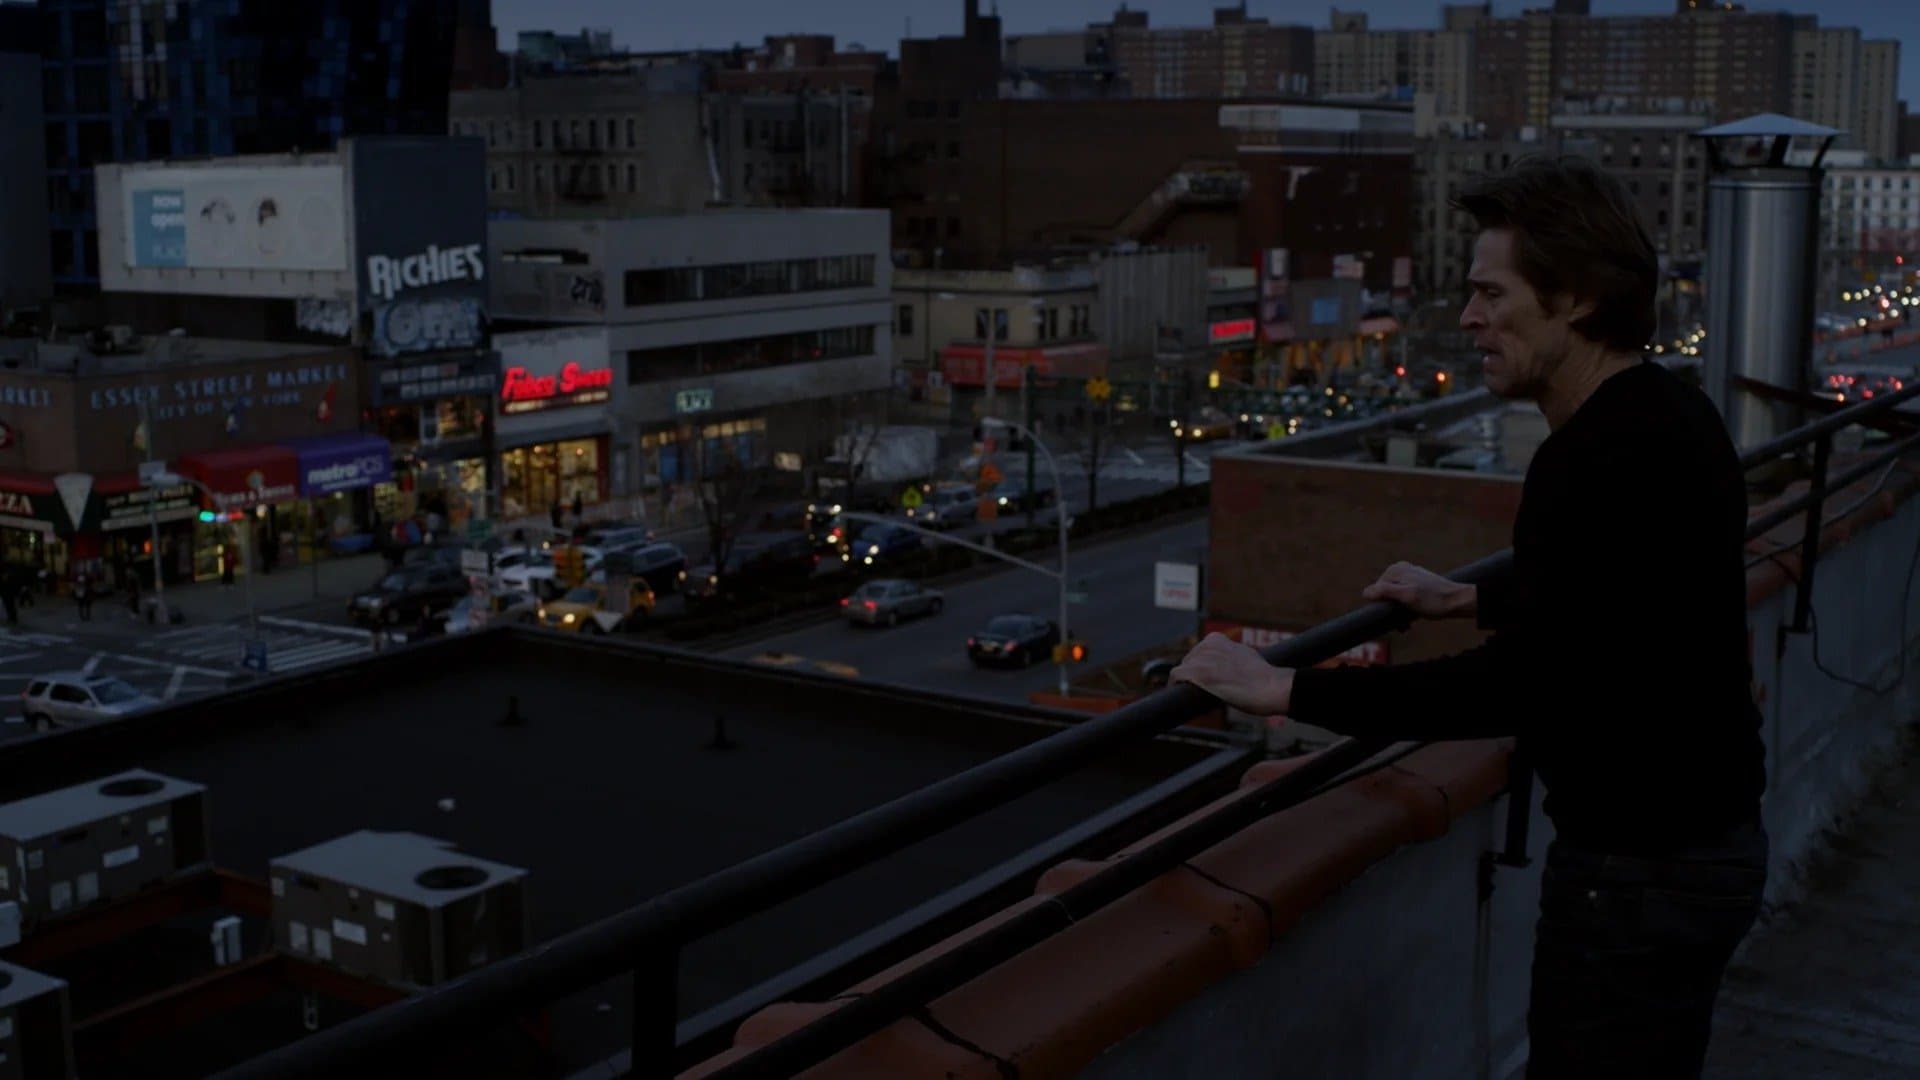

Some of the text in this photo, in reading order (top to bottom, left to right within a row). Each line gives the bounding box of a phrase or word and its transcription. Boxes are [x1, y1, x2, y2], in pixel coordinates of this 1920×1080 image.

[0, 385, 53, 407] RKET
[89, 363, 347, 410] ESSEX STREET MARKET
